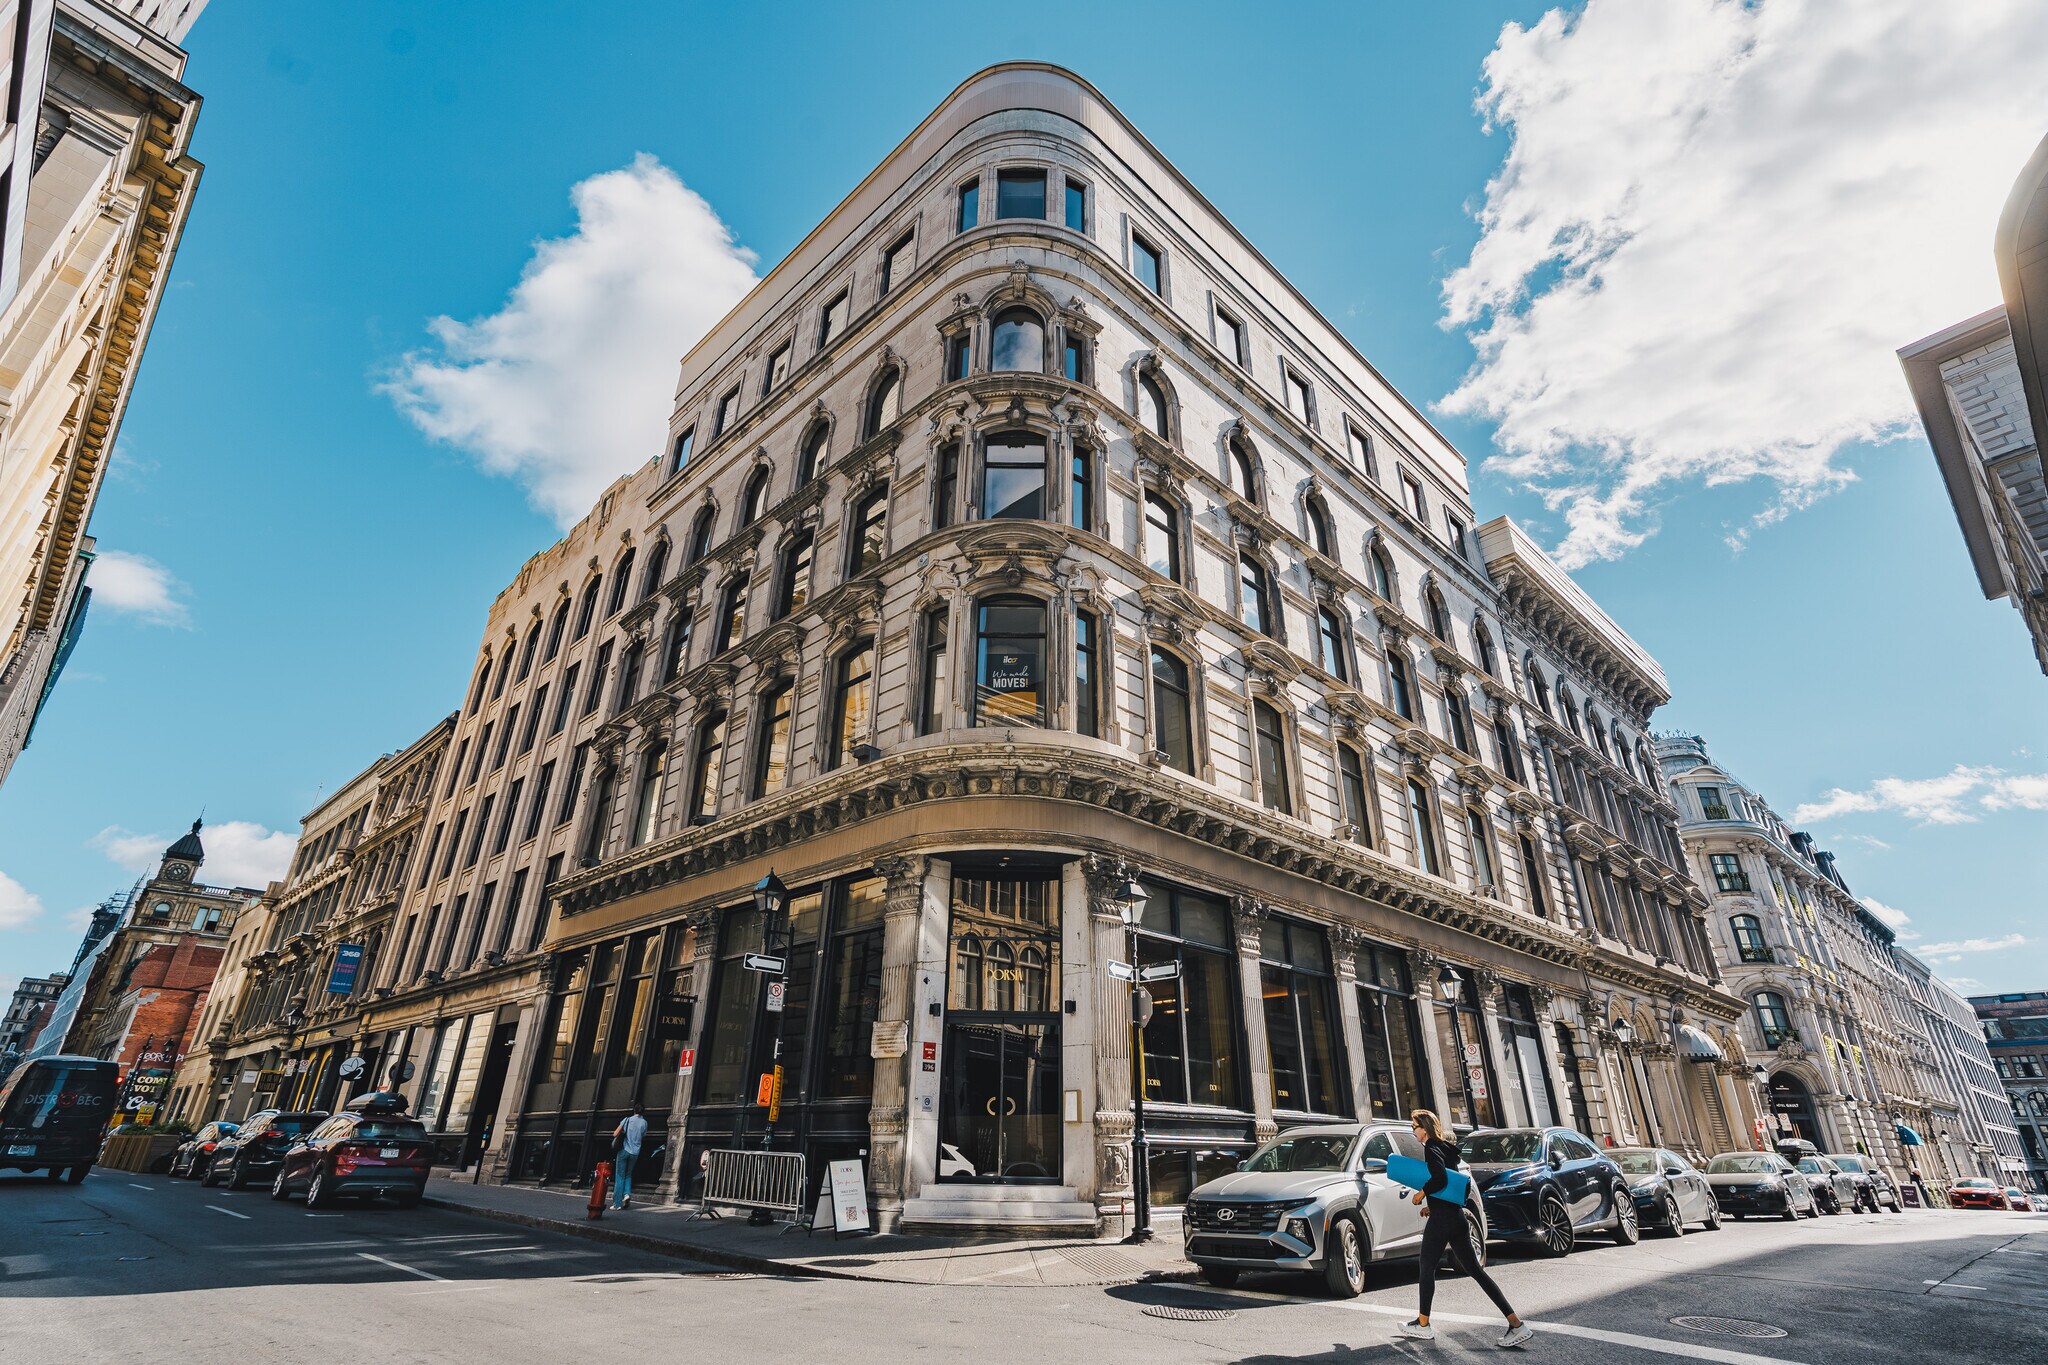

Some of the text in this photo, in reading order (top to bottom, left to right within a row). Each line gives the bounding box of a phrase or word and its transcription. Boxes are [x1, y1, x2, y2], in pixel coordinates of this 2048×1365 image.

[992, 665, 1029, 678] We made
[993, 678, 1029, 688] MOVES!
[987, 969, 1023, 980] DORSIA
